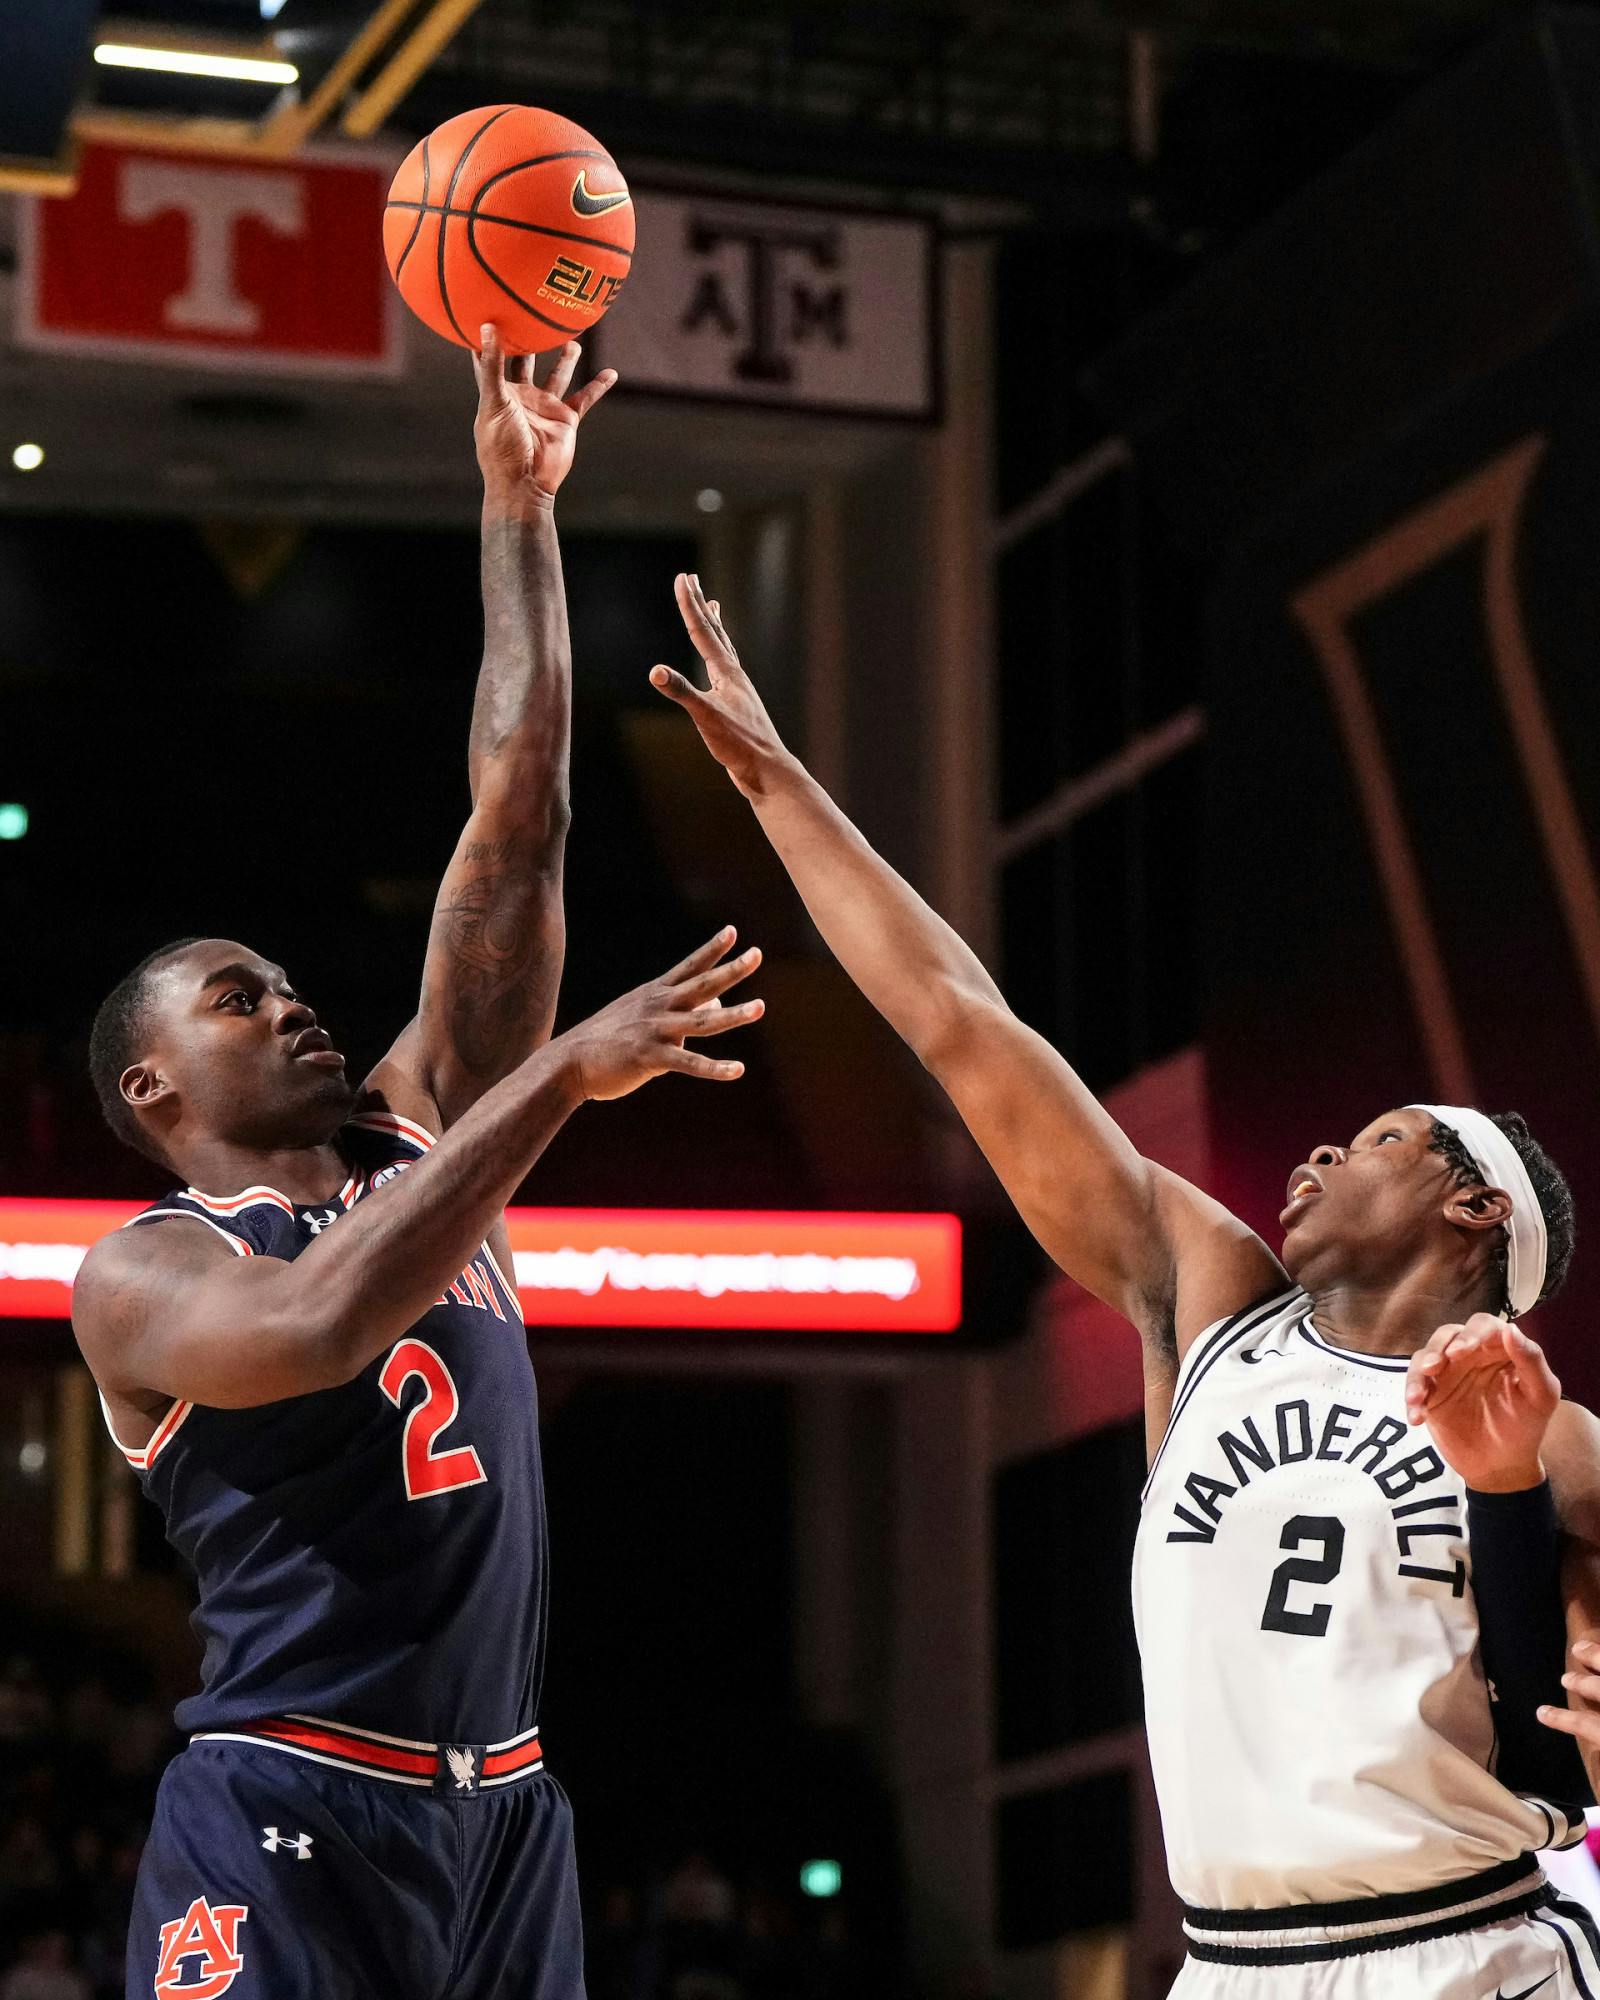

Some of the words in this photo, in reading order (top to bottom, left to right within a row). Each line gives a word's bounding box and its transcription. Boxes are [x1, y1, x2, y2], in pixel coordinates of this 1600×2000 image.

[120, 161, 305, 336] T
[378, 1338, 488, 1501] 2
[1166, 1399, 1465, 1598] VANDERBILT
[1260, 1514, 1346, 1637] 2
